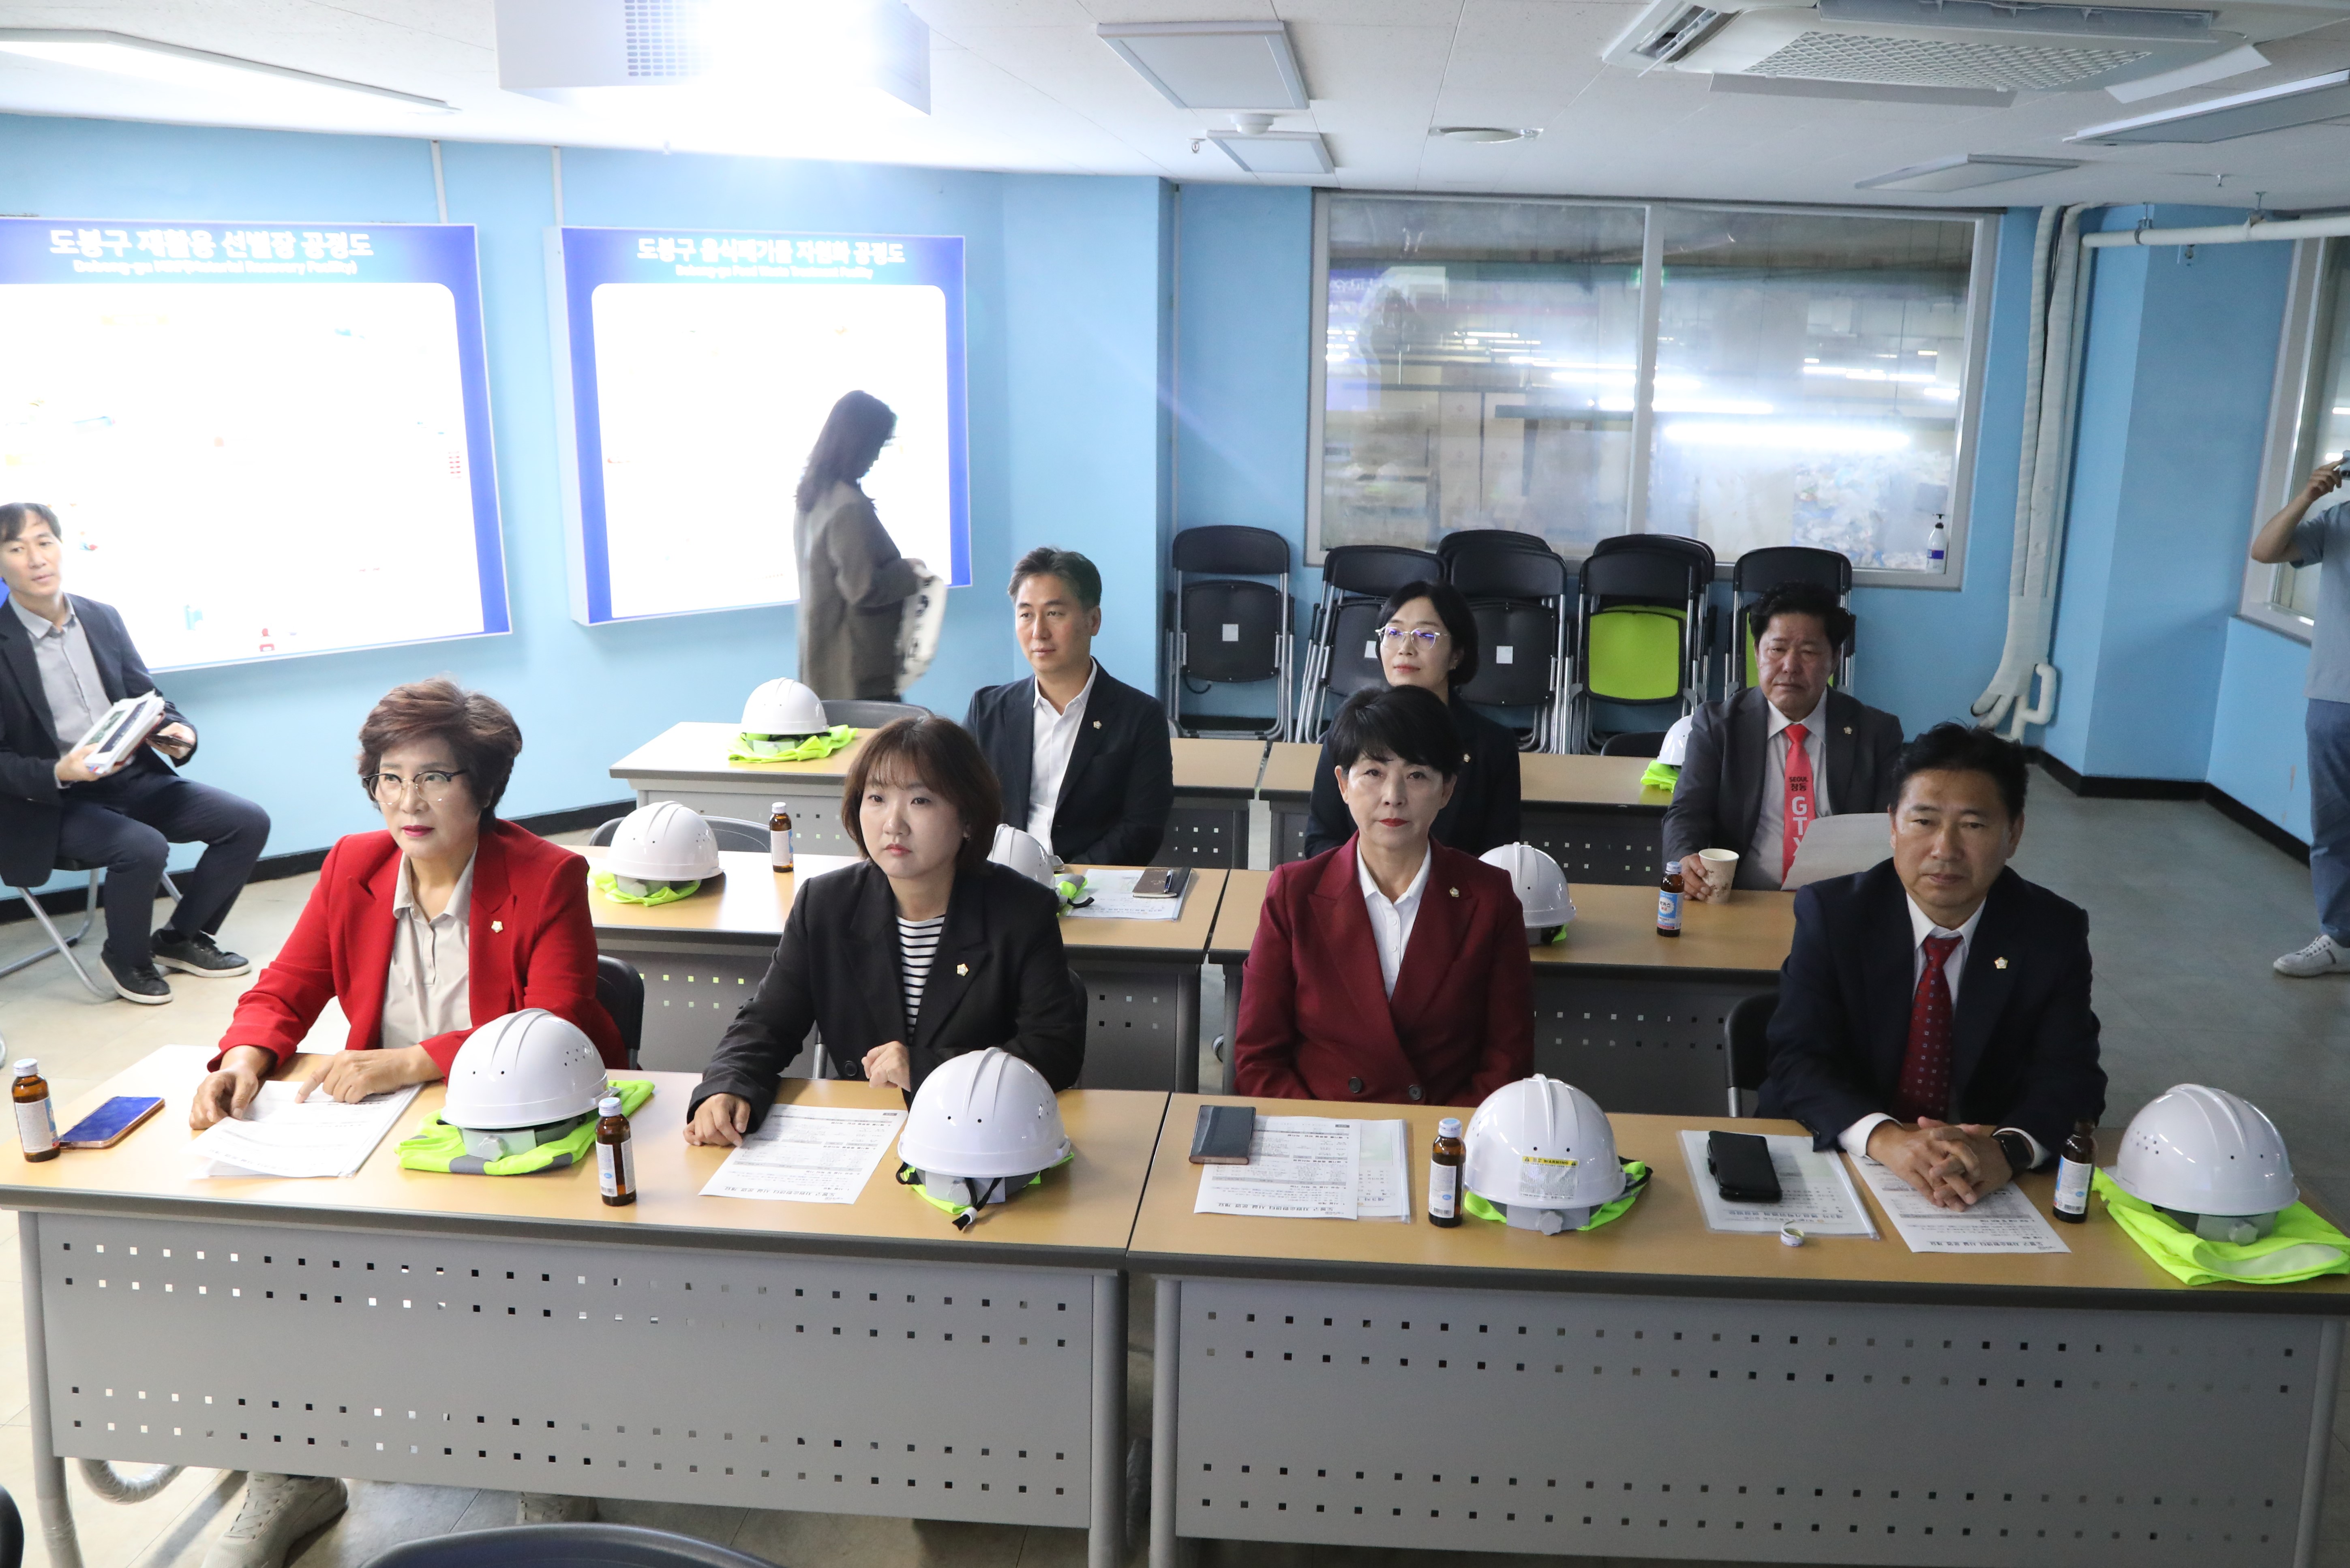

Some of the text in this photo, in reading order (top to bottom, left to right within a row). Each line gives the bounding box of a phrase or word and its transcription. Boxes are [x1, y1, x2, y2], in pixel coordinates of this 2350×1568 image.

[50, 229, 132, 258] 도봉구
[136, 229, 216, 259] 재활용
[301, 231, 374, 260] 공정도
[637, 238, 696, 262] 도봉구
[1791, 783, 1807, 791] 창동
